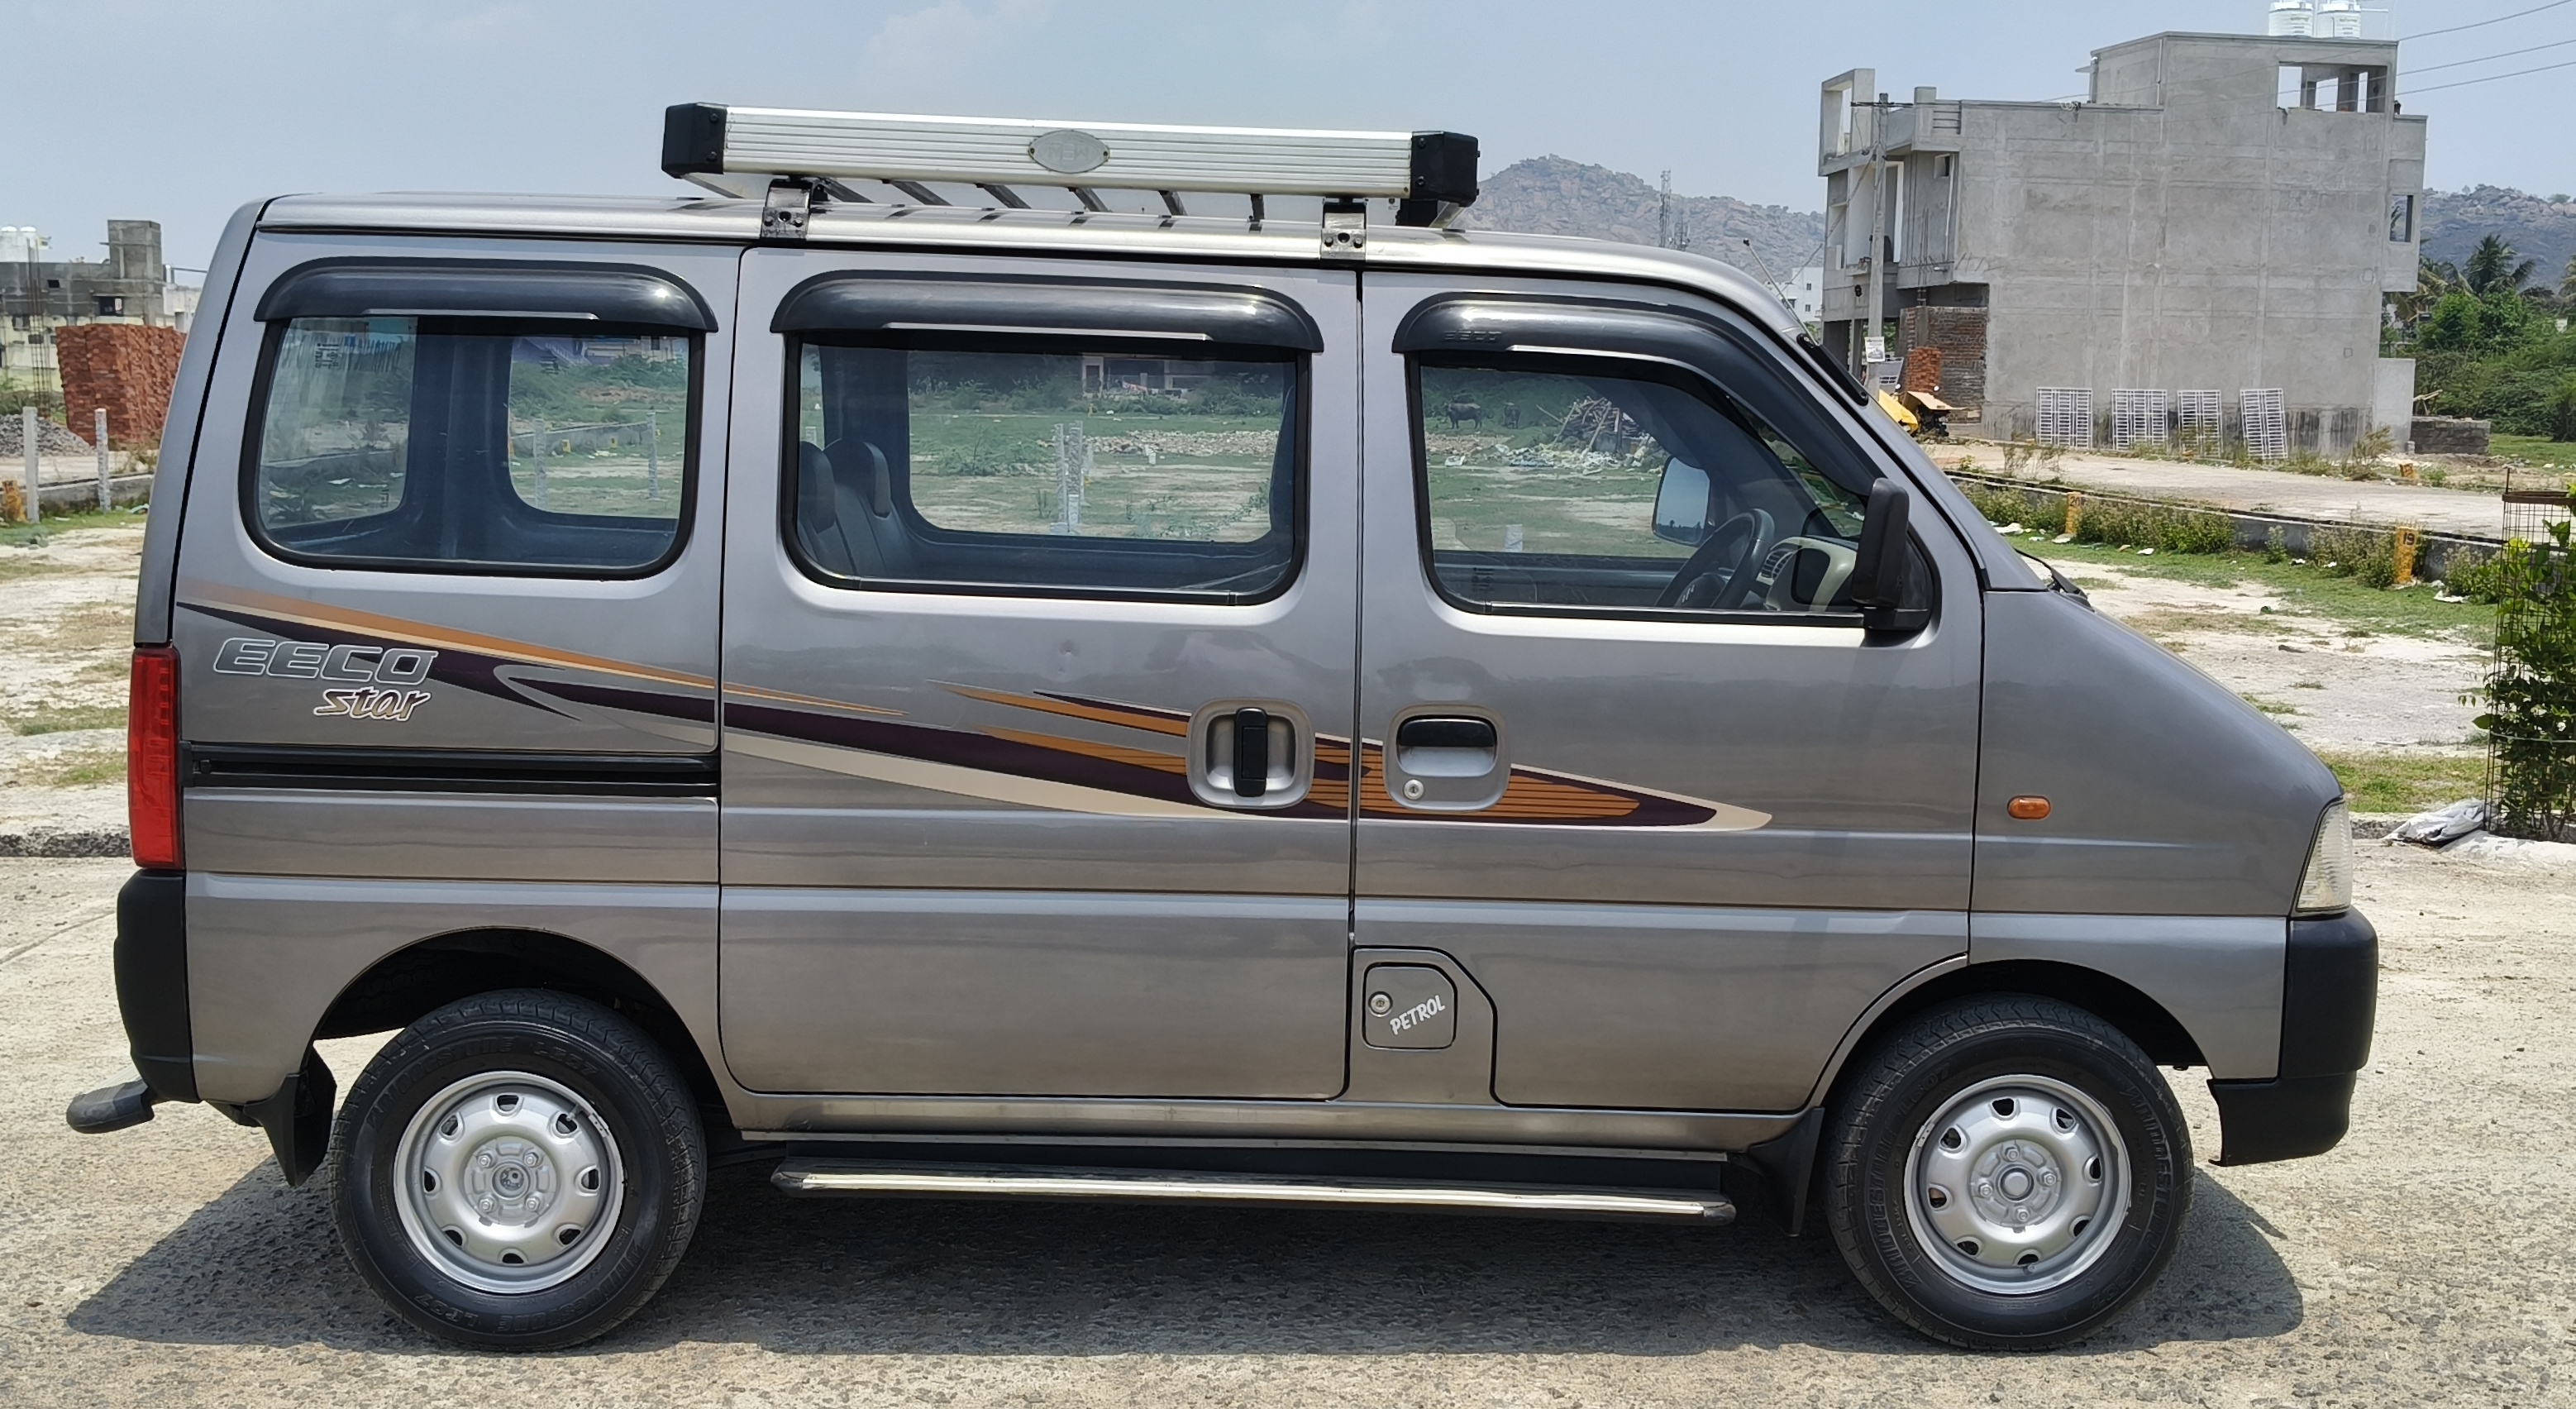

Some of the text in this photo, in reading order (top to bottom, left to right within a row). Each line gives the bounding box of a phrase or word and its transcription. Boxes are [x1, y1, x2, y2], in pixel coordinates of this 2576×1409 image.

[2402, 532, 2415, 546] 19
[213, 638, 438, 685] EECO
[313, 686, 431, 722] star
[1390, 995, 1446, 1035] PETROL
